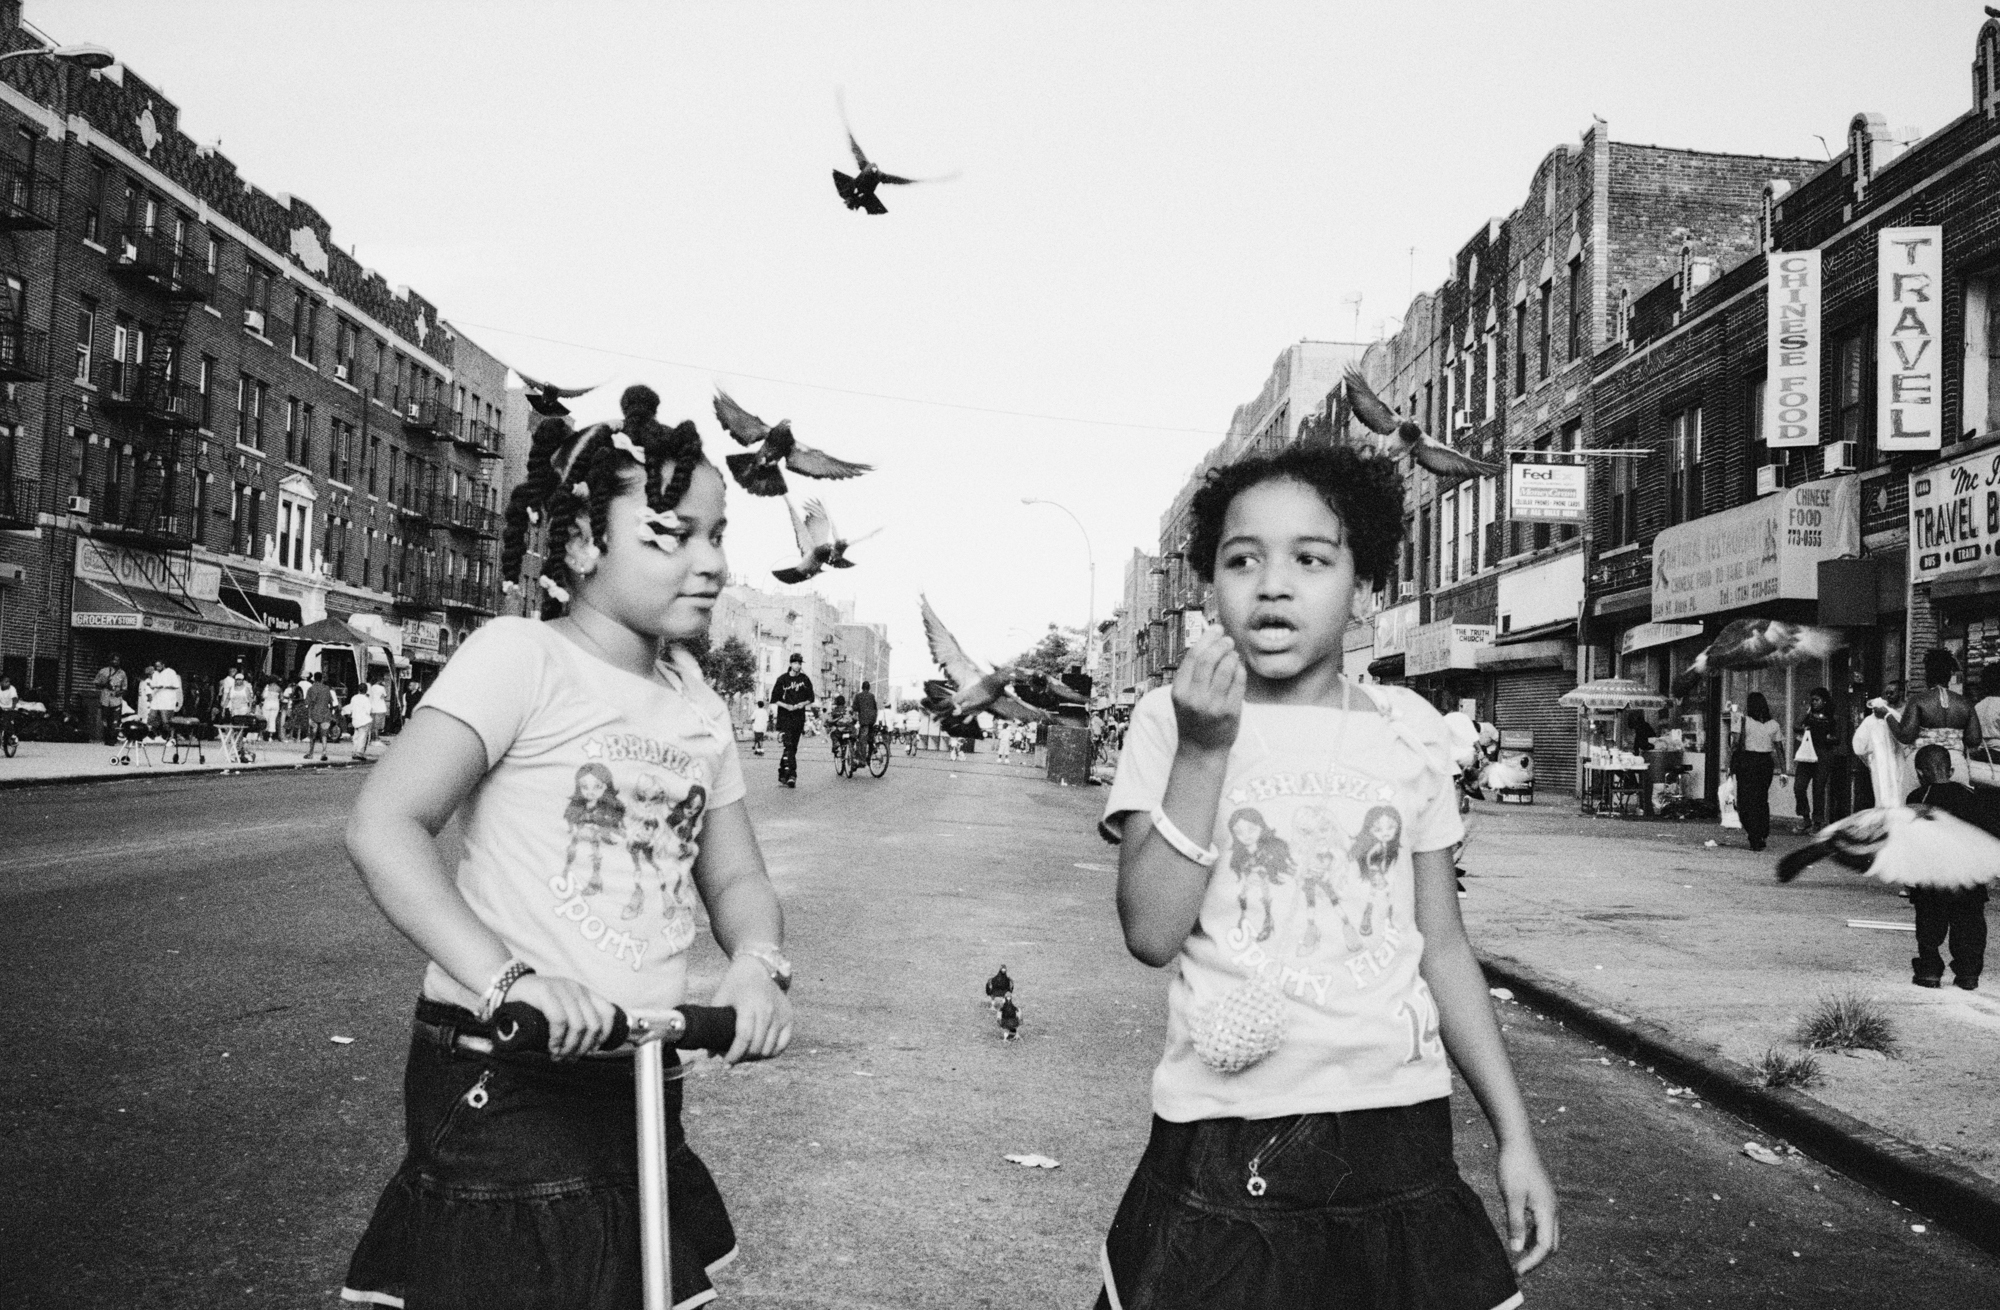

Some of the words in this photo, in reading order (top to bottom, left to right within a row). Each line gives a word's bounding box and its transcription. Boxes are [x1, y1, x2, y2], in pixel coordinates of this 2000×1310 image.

[1779, 258, 1809, 368] CHINESE
[1890, 238, 1932, 438] TRAVEL
[1778, 376, 1809, 440] FOOD
[1796, 488, 1830, 507] CHINESE
[1789, 508, 1821, 527] FOOD
[1914, 496, 1979, 549] TRAVEL
[1788, 529, 1822, 547] 773-0555
[1957, 547, 1976, 560] TRAIN
[77, 614, 117, 625] GROCERY
[118, 616, 137, 625] STORE
[1455, 628, 1467, 636] THE
[1459, 635, 1484, 643] CHURCH
[1249, 771, 1371, 802] BRATZ
